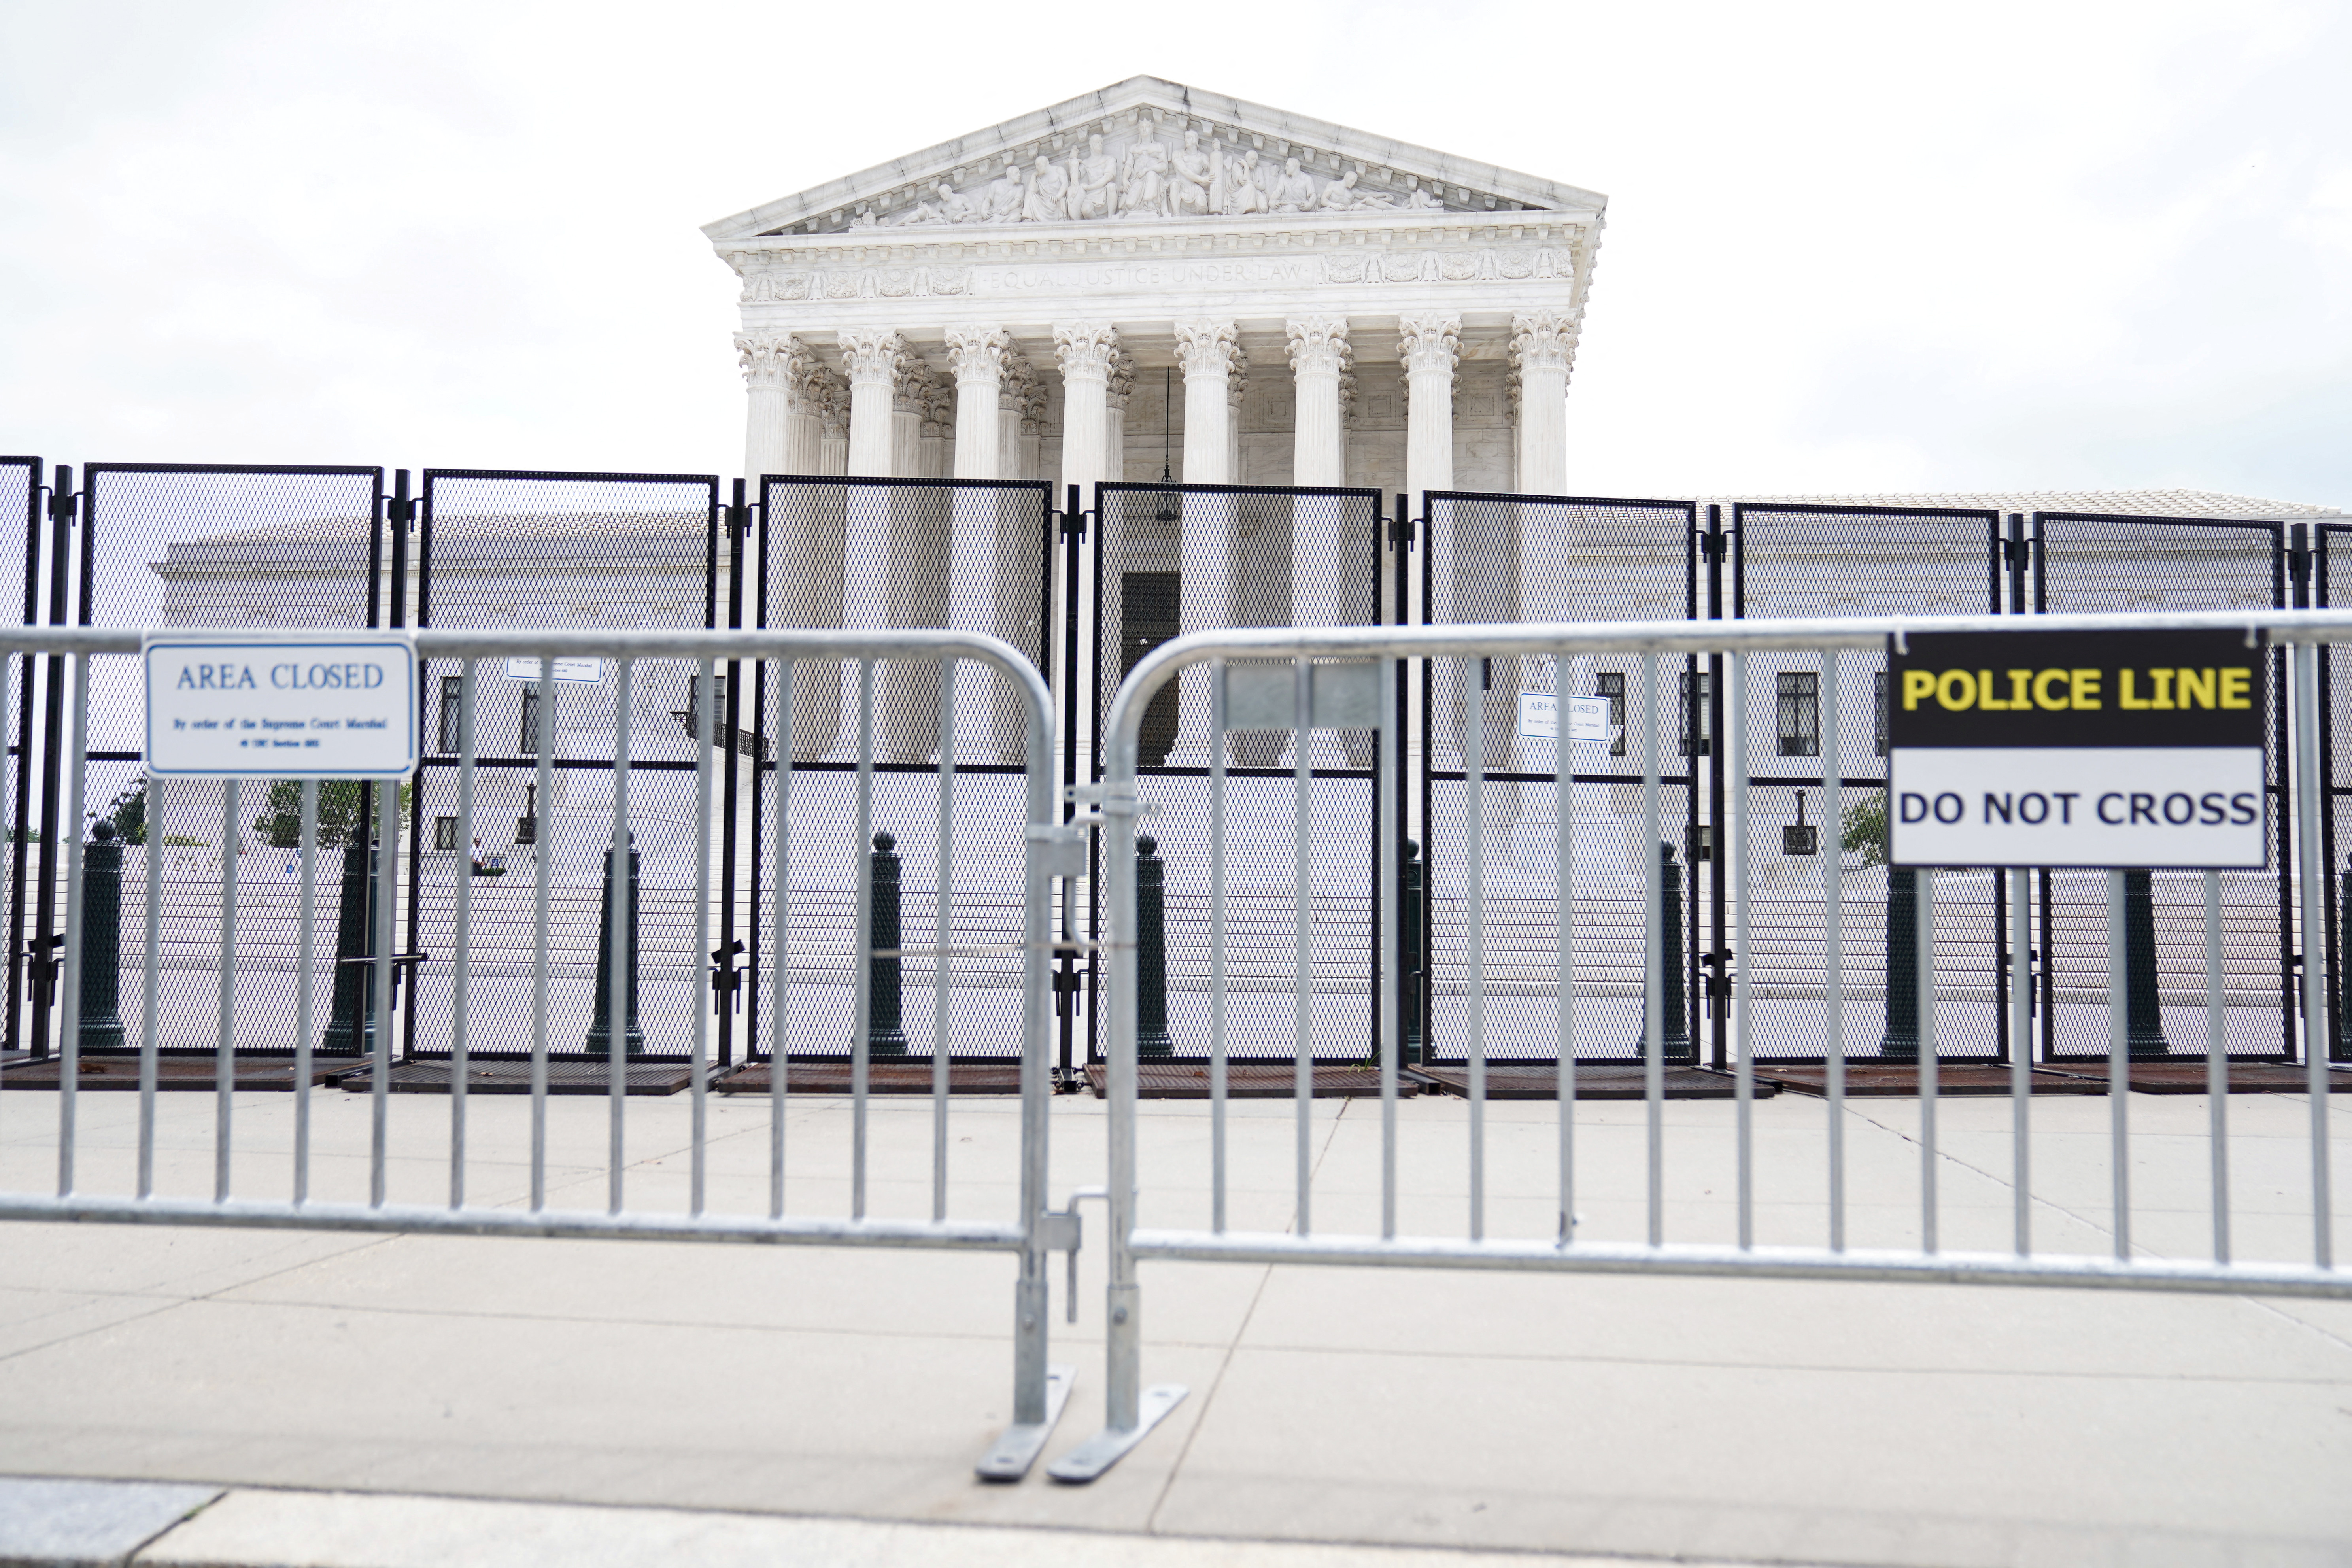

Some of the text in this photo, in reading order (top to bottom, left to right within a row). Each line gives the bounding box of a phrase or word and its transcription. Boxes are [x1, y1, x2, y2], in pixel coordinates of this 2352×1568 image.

[991, 263, 1302, 289] EQUAL JUSTICE UNDER LAW
[176, 663, 383, 690] AREA CLOSED
[1902, 667, 2252, 711] POLICE LINE
[1529, 701, 1598, 714] AREA LOSED
[173, 718, 387, 731] By order of the Supreme Court Marshal
[1900, 792, 2258, 826] DO NOT CROSS
